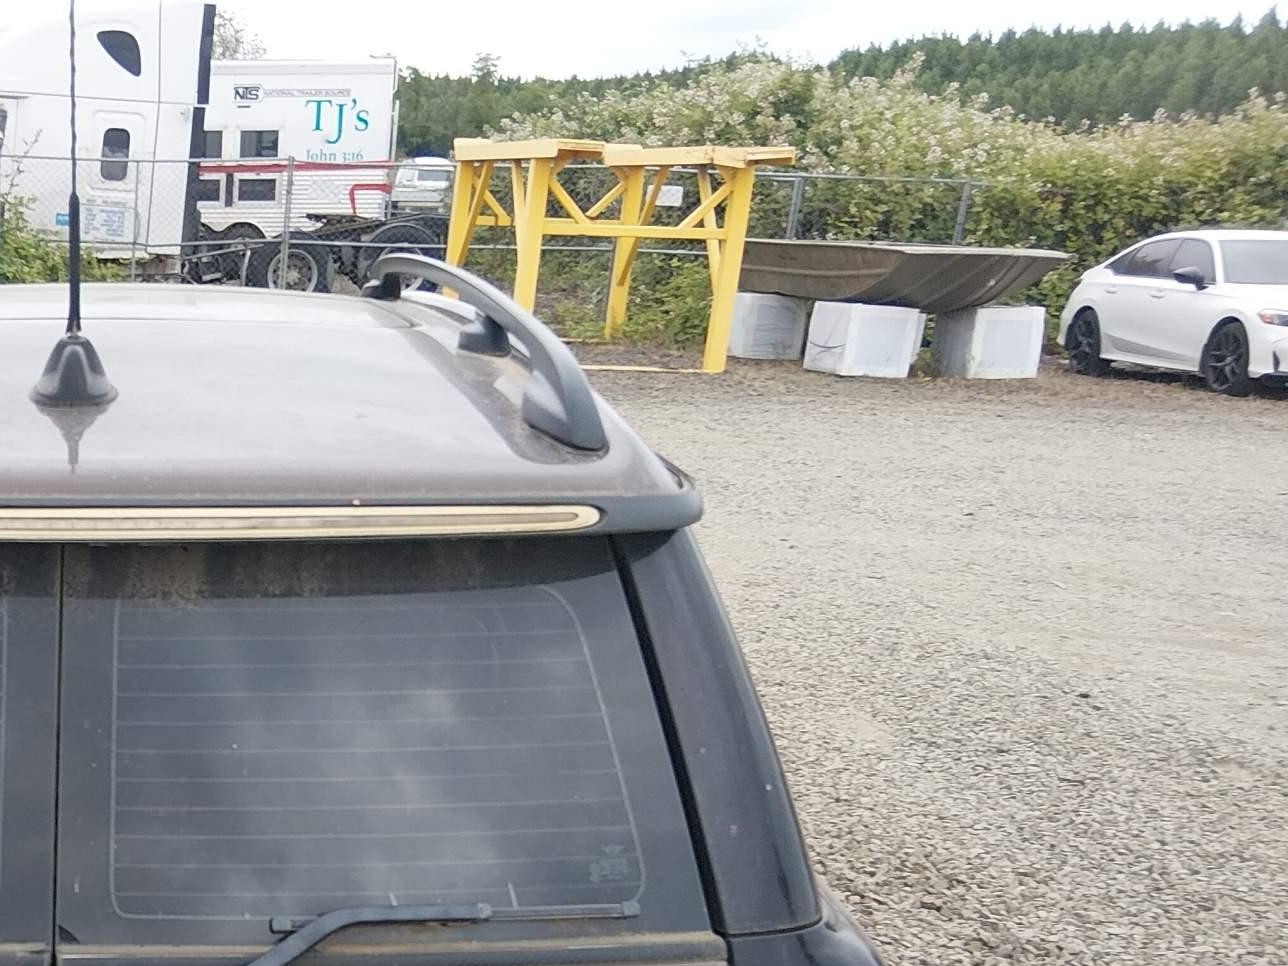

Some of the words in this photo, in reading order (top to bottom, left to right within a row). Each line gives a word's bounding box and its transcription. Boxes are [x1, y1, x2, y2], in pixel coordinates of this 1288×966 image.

[233, 87, 260, 100] NTS
[264, 89, 294, 97] NATIONAL
[297, 89, 323, 97] TRAILER
[305, 98, 369, 145] TJ's
[306, 149, 336, 161] John
